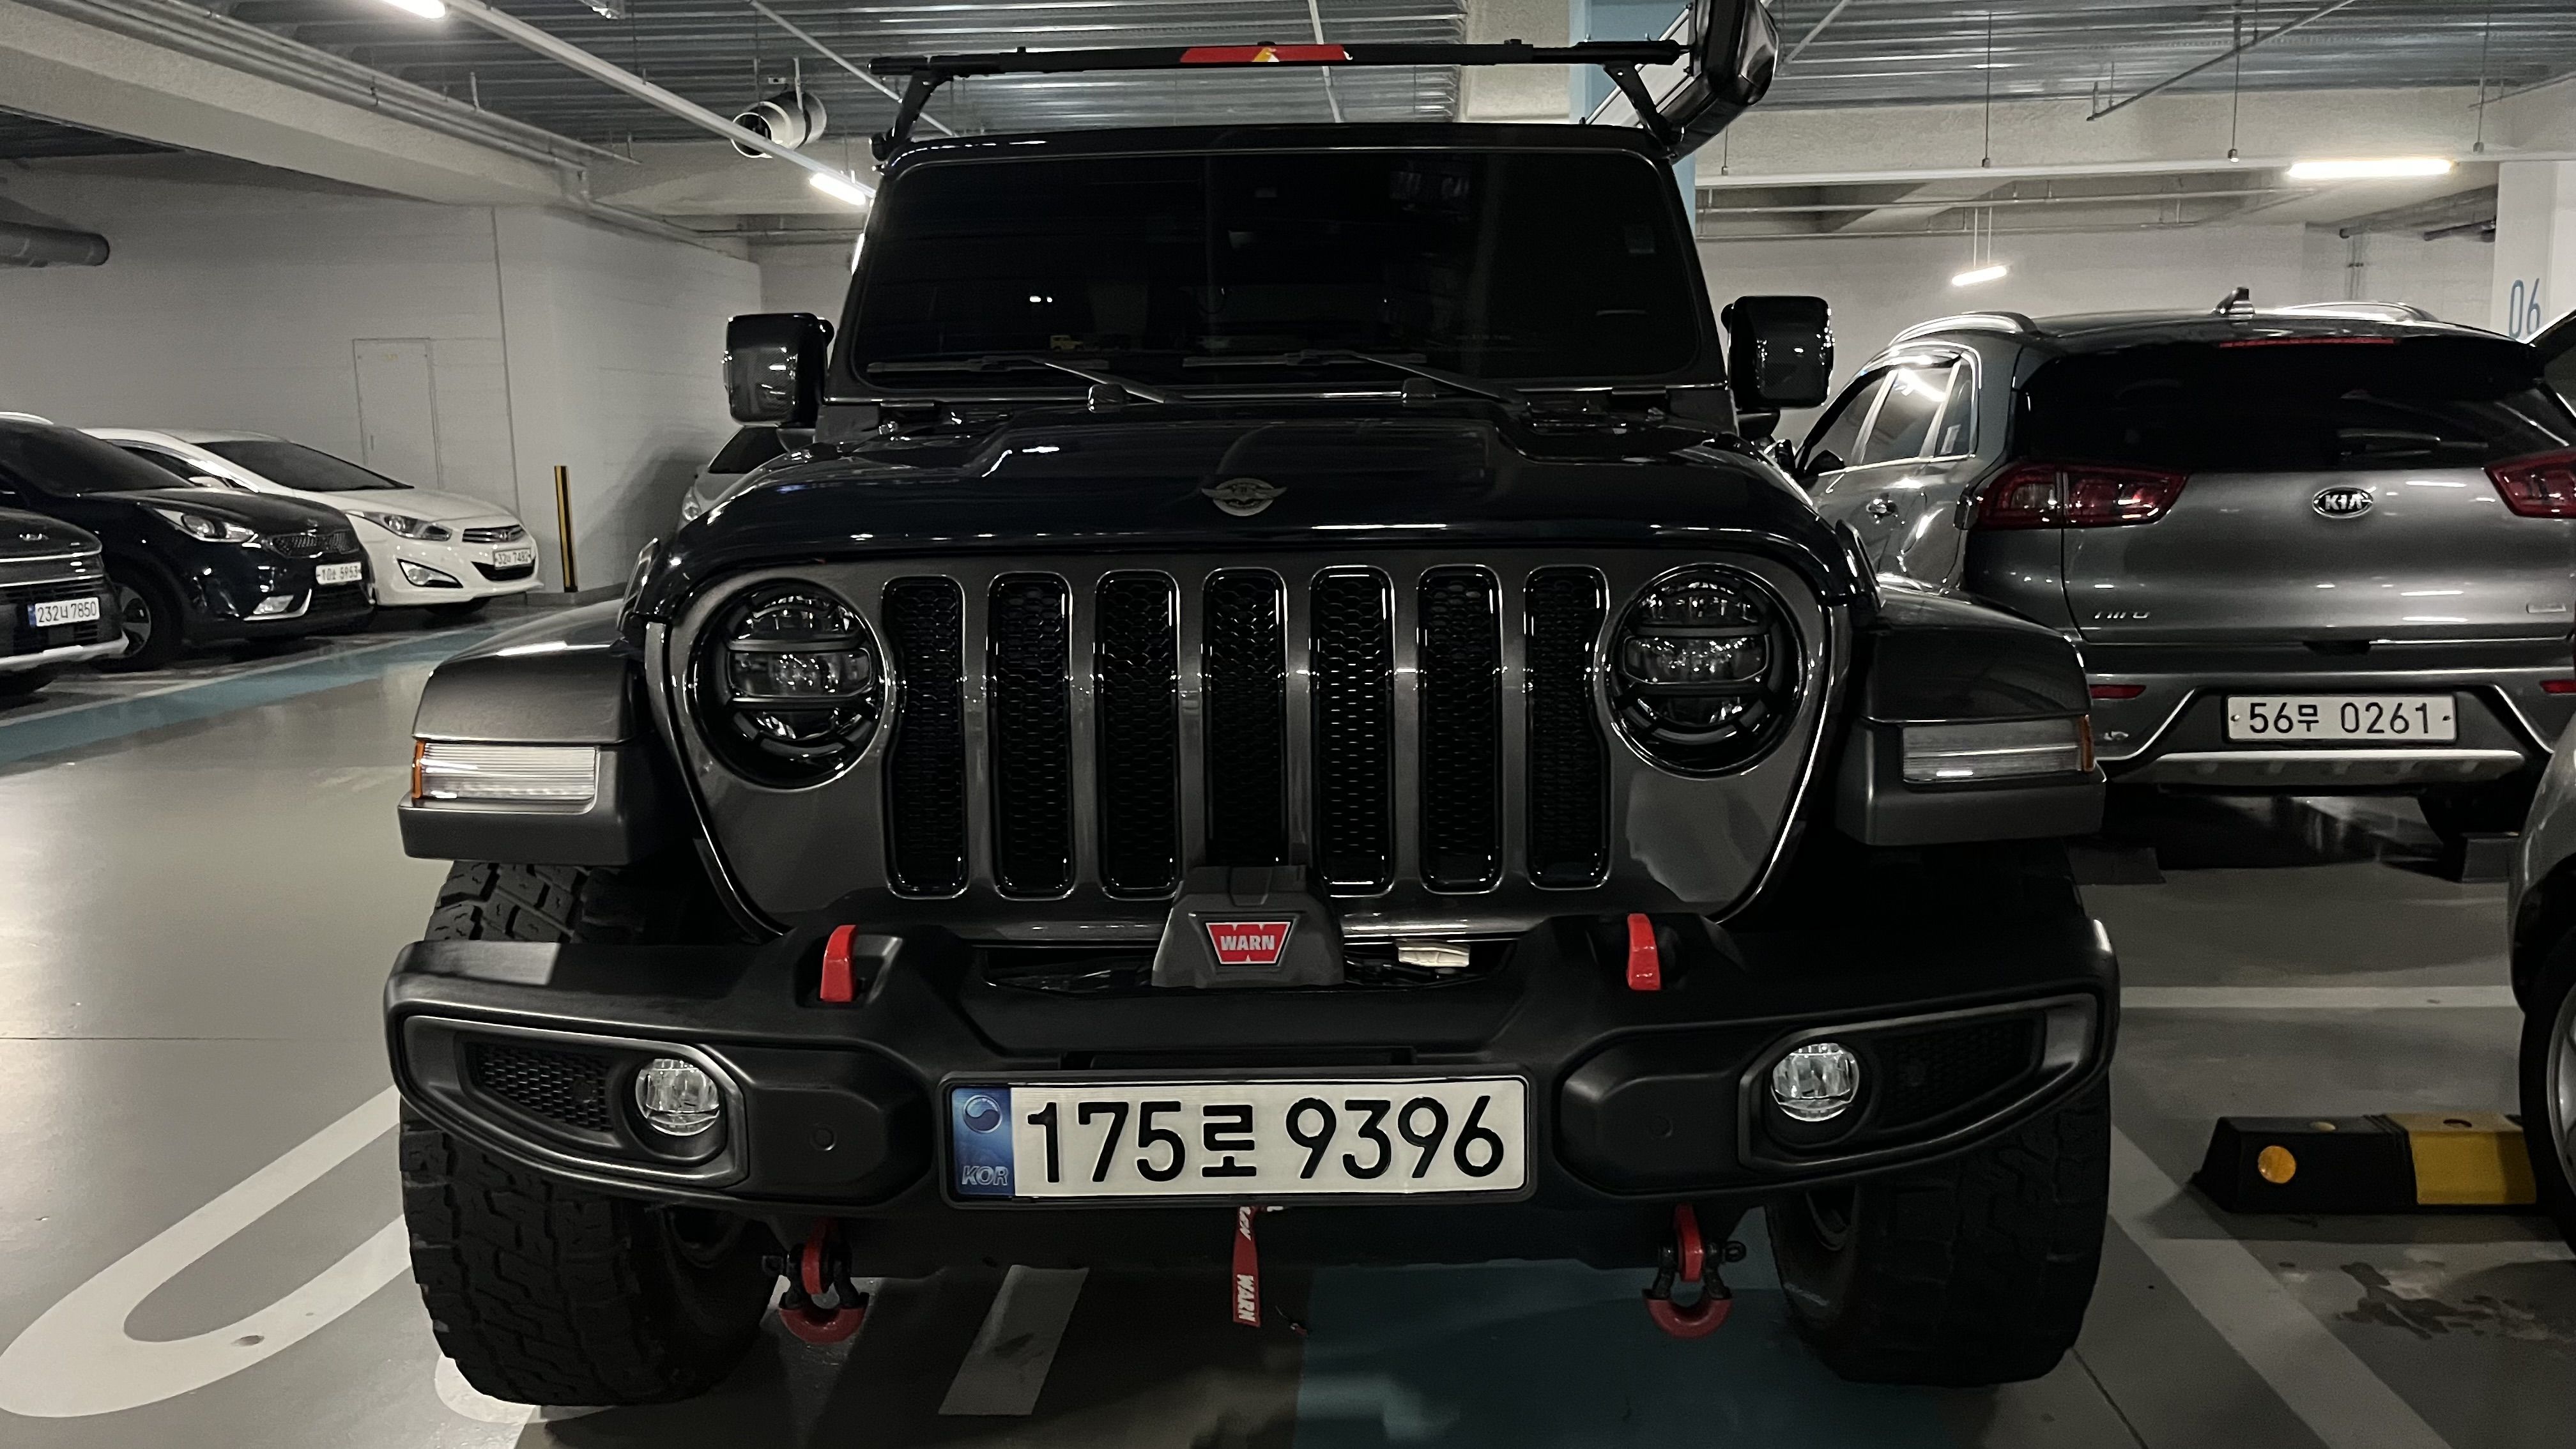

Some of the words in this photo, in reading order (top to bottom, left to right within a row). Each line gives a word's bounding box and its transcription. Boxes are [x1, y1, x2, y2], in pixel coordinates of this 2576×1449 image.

[2508, 278, 2541, 339] 06
[2325, 494, 2363, 510] KIA
[38, 606, 68, 623] 232너
[71, 601, 96, 618] 7850
[2250, 703, 2319, 734] 56무
[2340, 702, 2429, 734] 0261
[1220, 935, 1275, 951] WARN
[1027, 1100, 1257, 1183] 175로
[1285, 1095, 1505, 1179] 9396
[961, 1165, 1009, 1186] KOR
[1237, 1274, 1256, 1322] WARN
